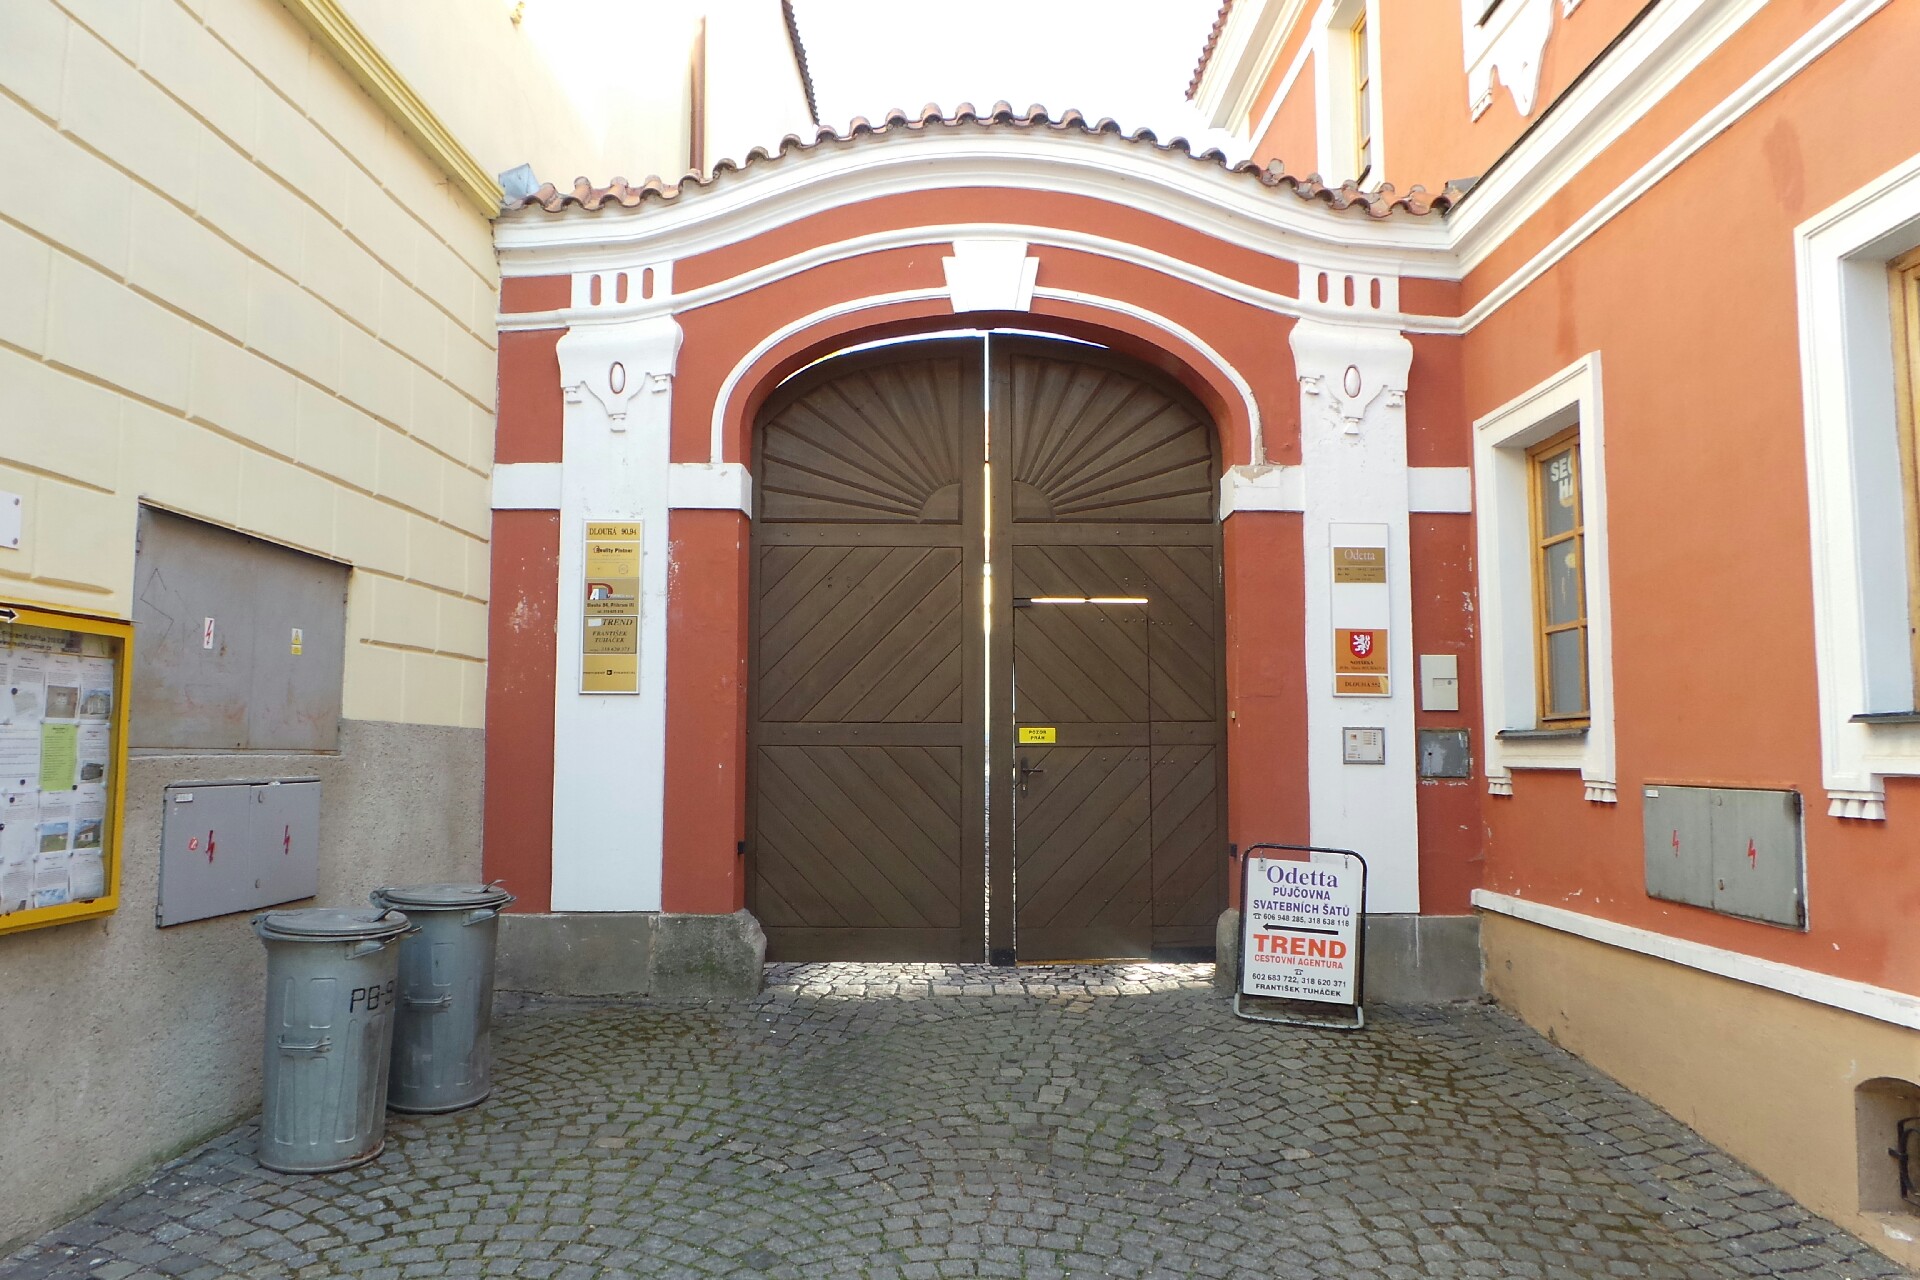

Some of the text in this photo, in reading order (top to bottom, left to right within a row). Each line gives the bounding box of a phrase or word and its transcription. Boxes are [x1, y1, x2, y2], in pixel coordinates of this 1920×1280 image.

[589, 526, 617, 536] DLOUHÁ
[1344, 548, 1375, 560] Odetta
[602, 618, 633, 626] TREND
[1266, 865, 1338, 888] Odetta
[1273, 885, 1331, 900] PŮJČOVNA
[1253, 899, 1350, 917] SVATEBNÍCH ŠATŮ
[1263, 913, 1276, 921] 606
[1308, 917, 1321, 925] 318
[1337, 919, 1350, 927] 118
[1253, 933, 1347, 959] TREND
[1254, 954, 1344, 970] CESTOVNÍ AGENTURA
[1252, 972, 1266, 980] 602
[1301, 977, 1315, 985] 318
[1317, 979, 1331, 987] 620
[1333, 980, 1346, 988] 371
[1255, 983, 1342, 997] FRANTIŠEK TUHÁČEK
